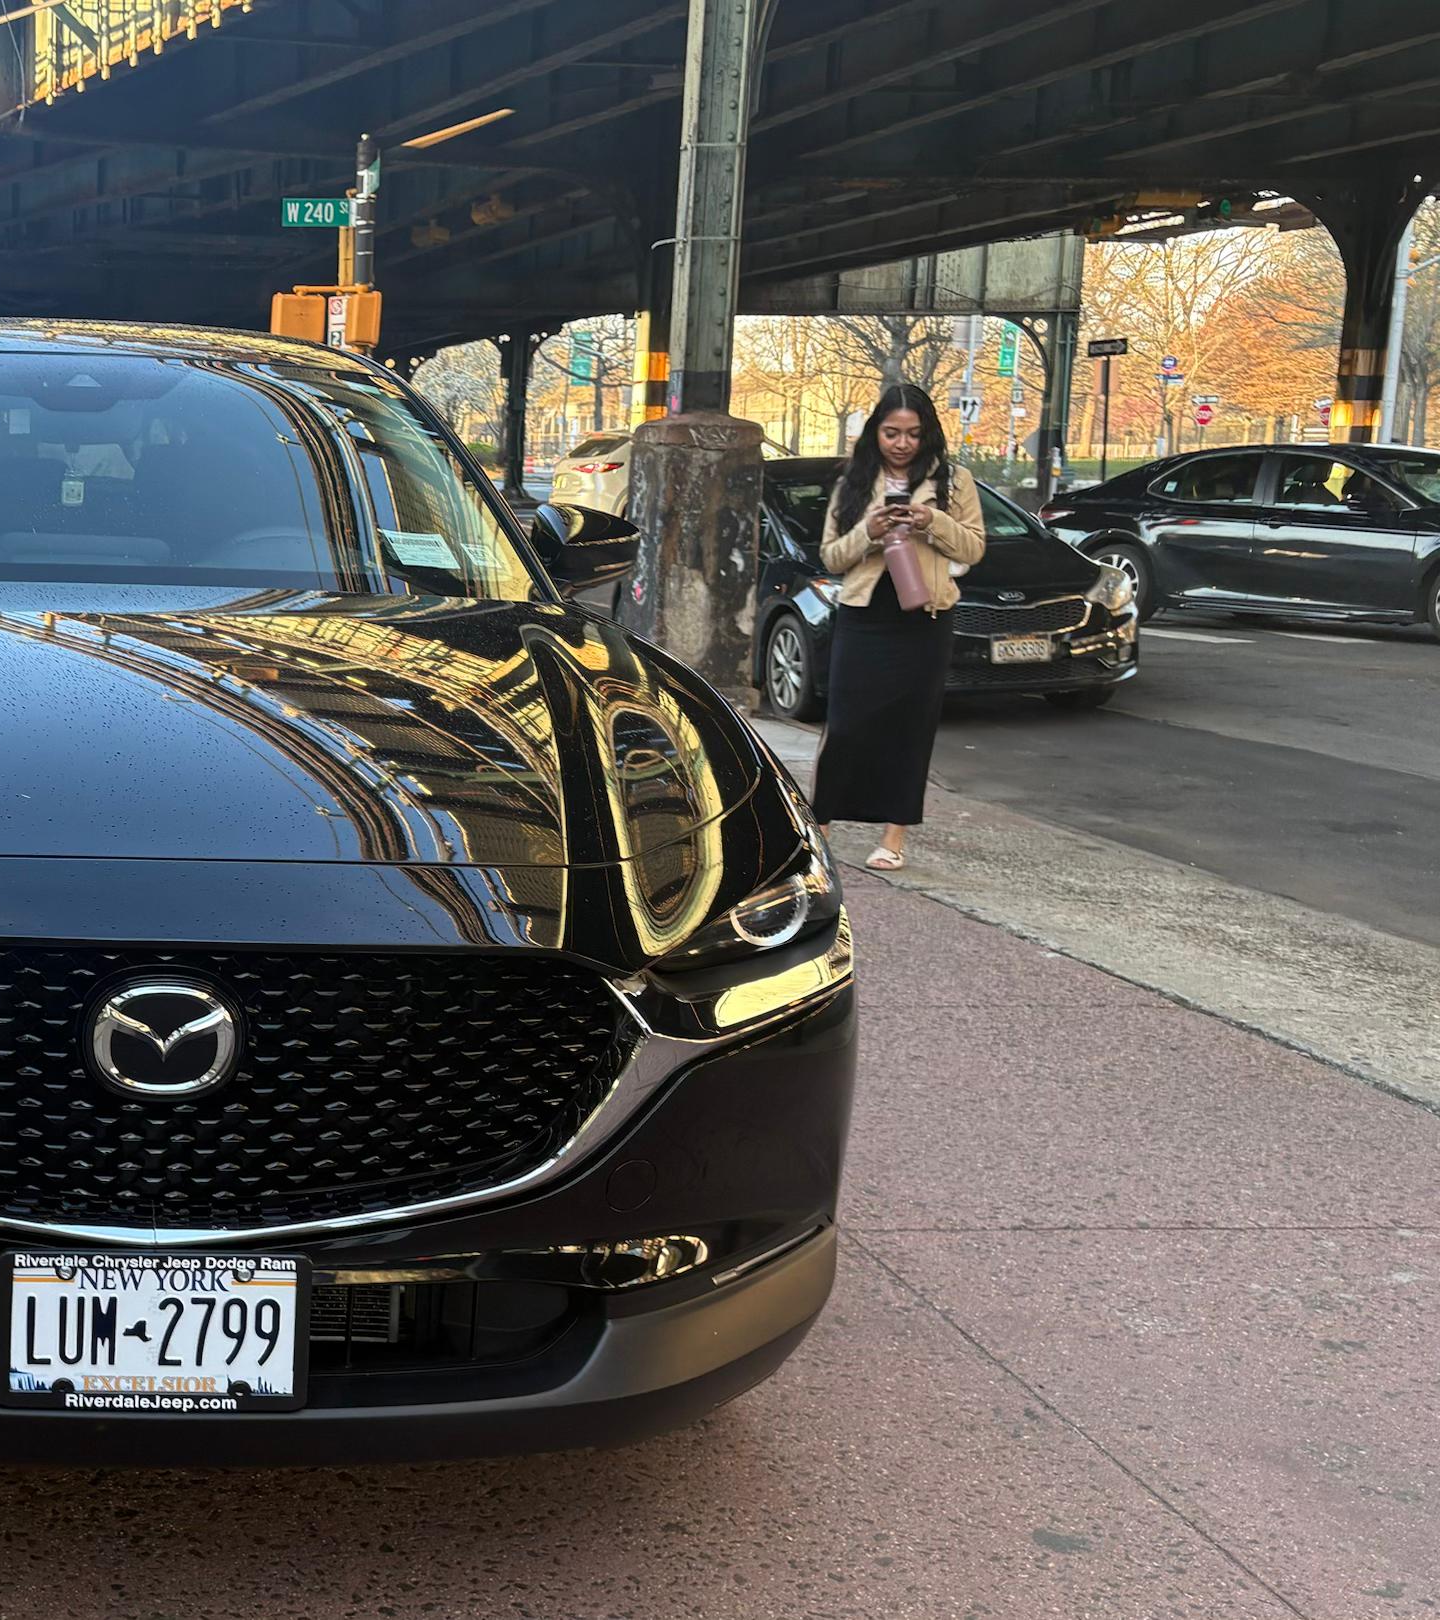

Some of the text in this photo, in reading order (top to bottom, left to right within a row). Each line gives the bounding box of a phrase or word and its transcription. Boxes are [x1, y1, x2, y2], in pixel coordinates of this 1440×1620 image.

[287, 202, 300, 223] W
[304, 202, 334, 223] 240
[14, 1254, 297, 1271] Riverdale Chrysler Jeep Dodge Ram
[78, 1269, 232, 1293] NEW YORK
[83, 1375, 217, 1393] EXCELSIOR
[64, 1393, 238, 1411] RiverdaleJeep.com
